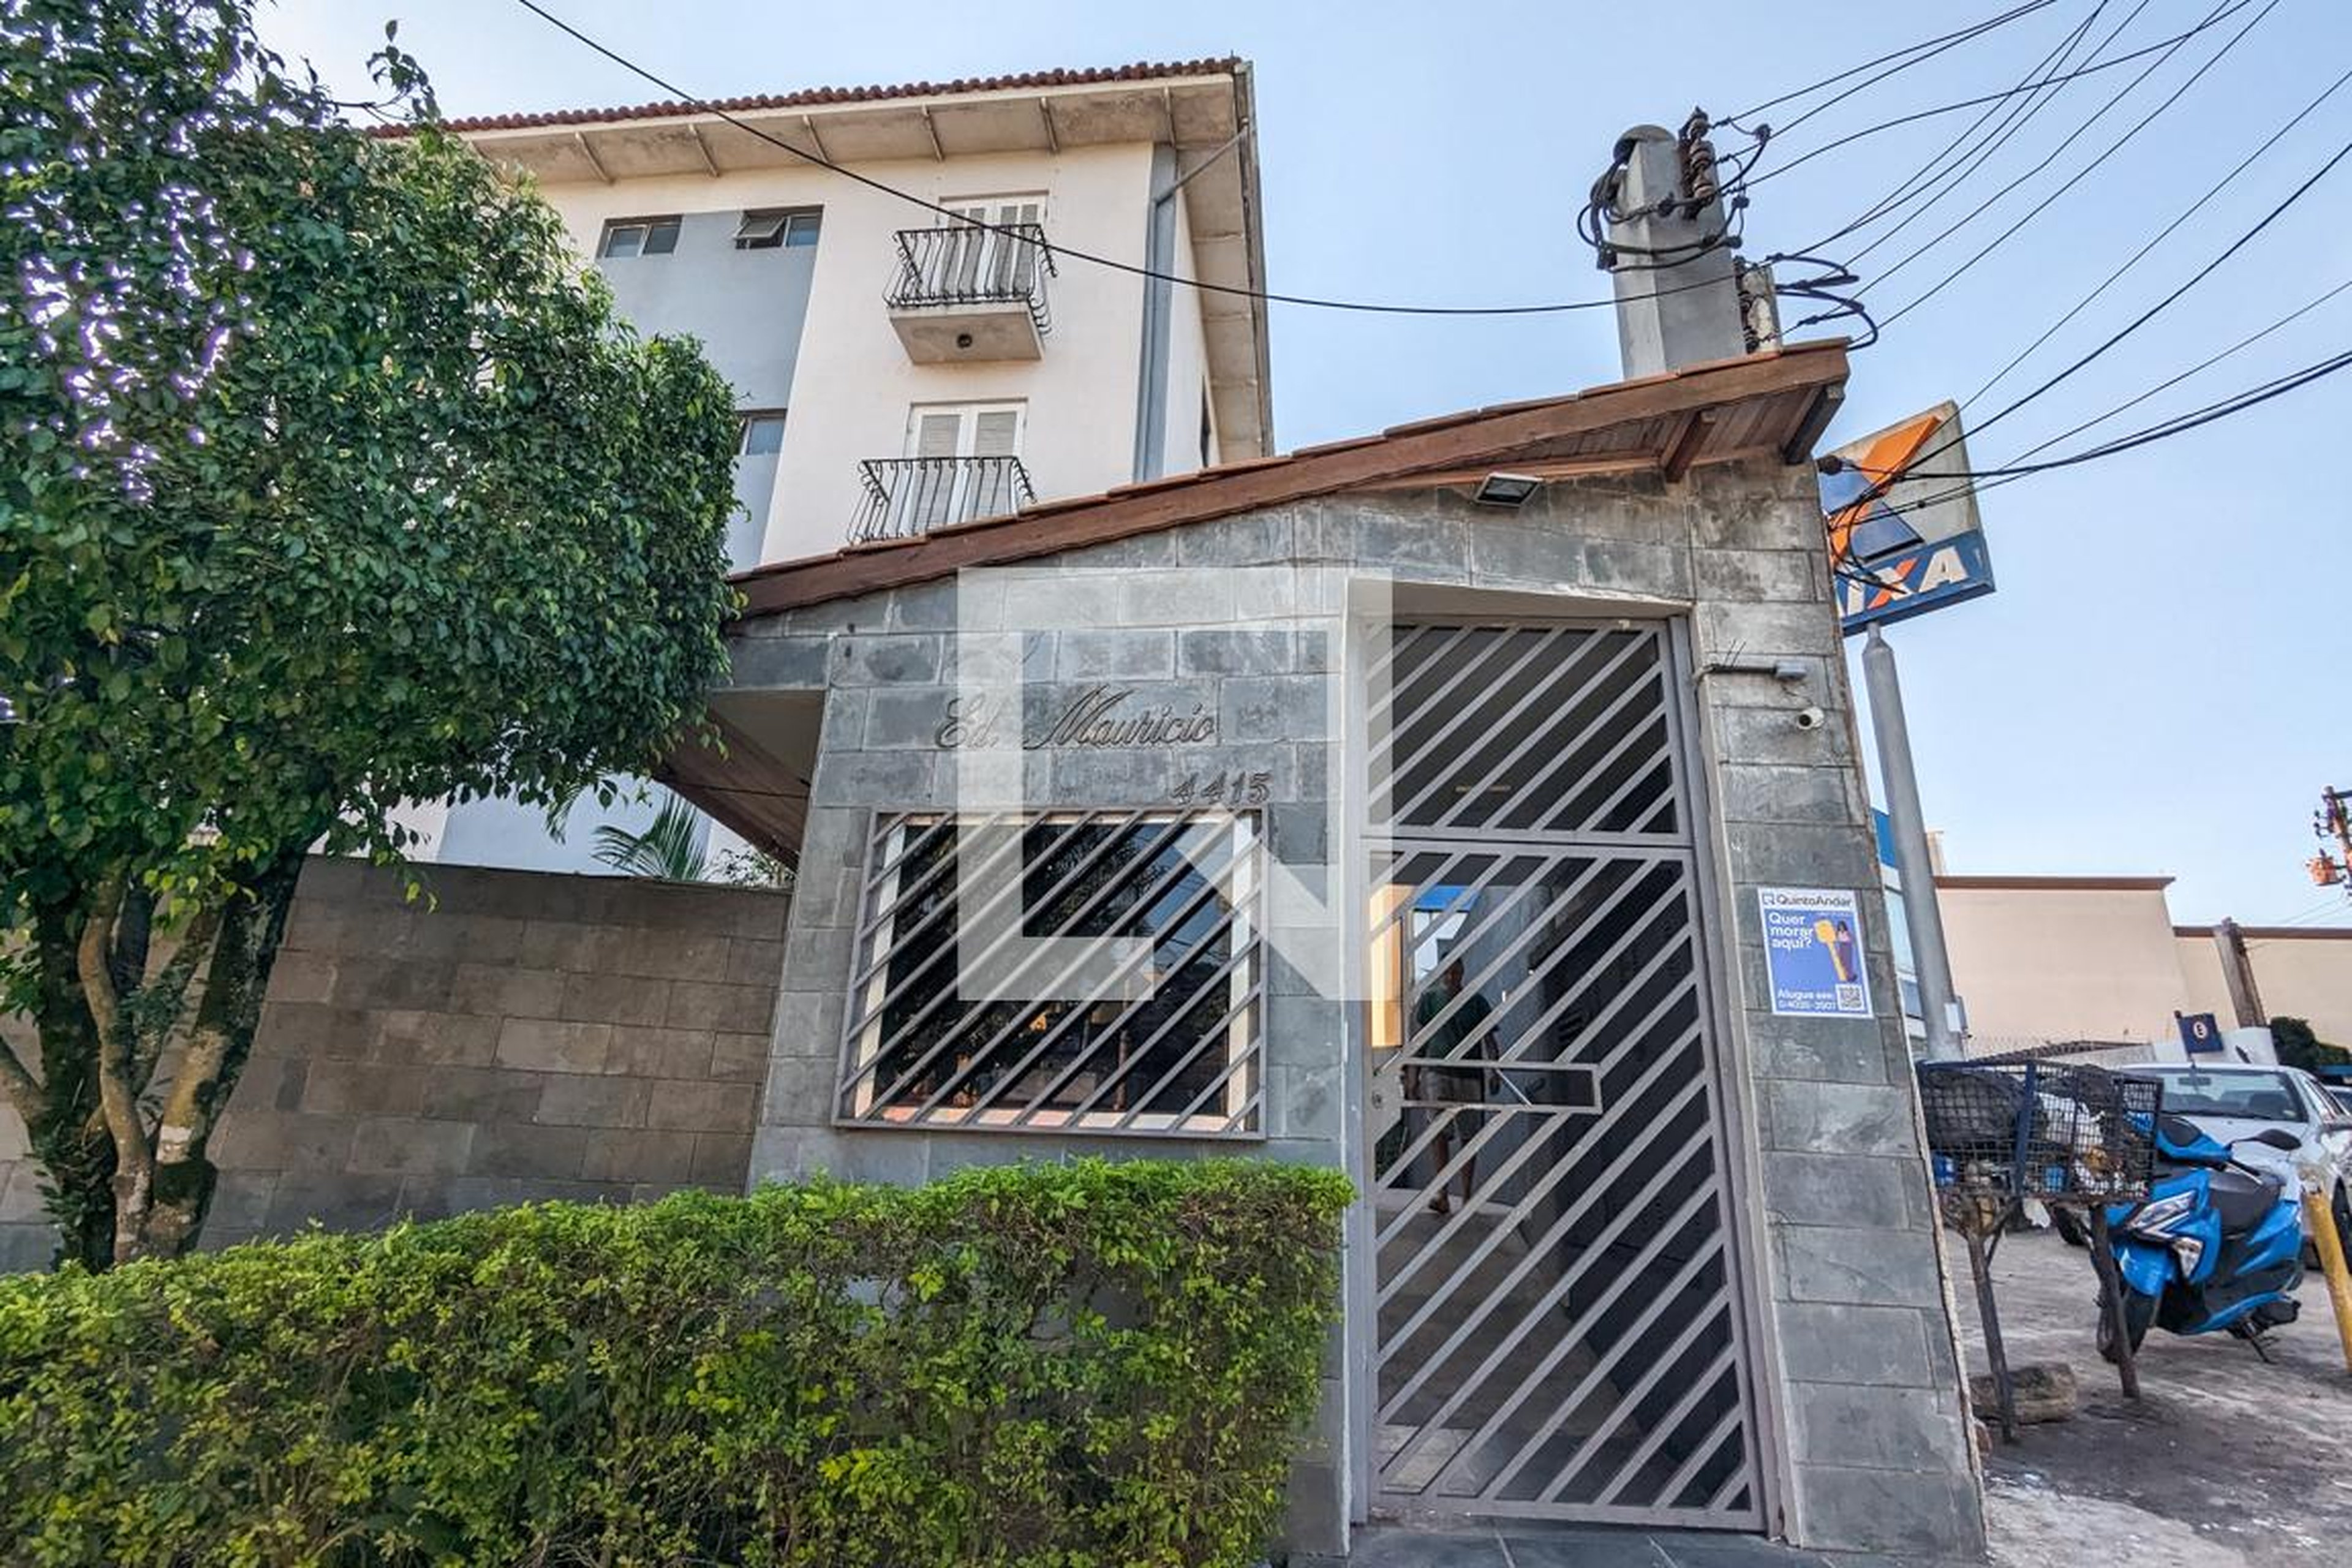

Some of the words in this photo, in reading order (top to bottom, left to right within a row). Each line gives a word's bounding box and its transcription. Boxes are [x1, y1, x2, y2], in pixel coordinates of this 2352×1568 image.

[1836, 546, 1969, 619] IXA
[1171, 772, 1273, 805] 4415
[1769, 912, 1805, 925] Quer
[1770, 927, 1813, 938] morar
[1772, 937, 1812, 951] aqui?
